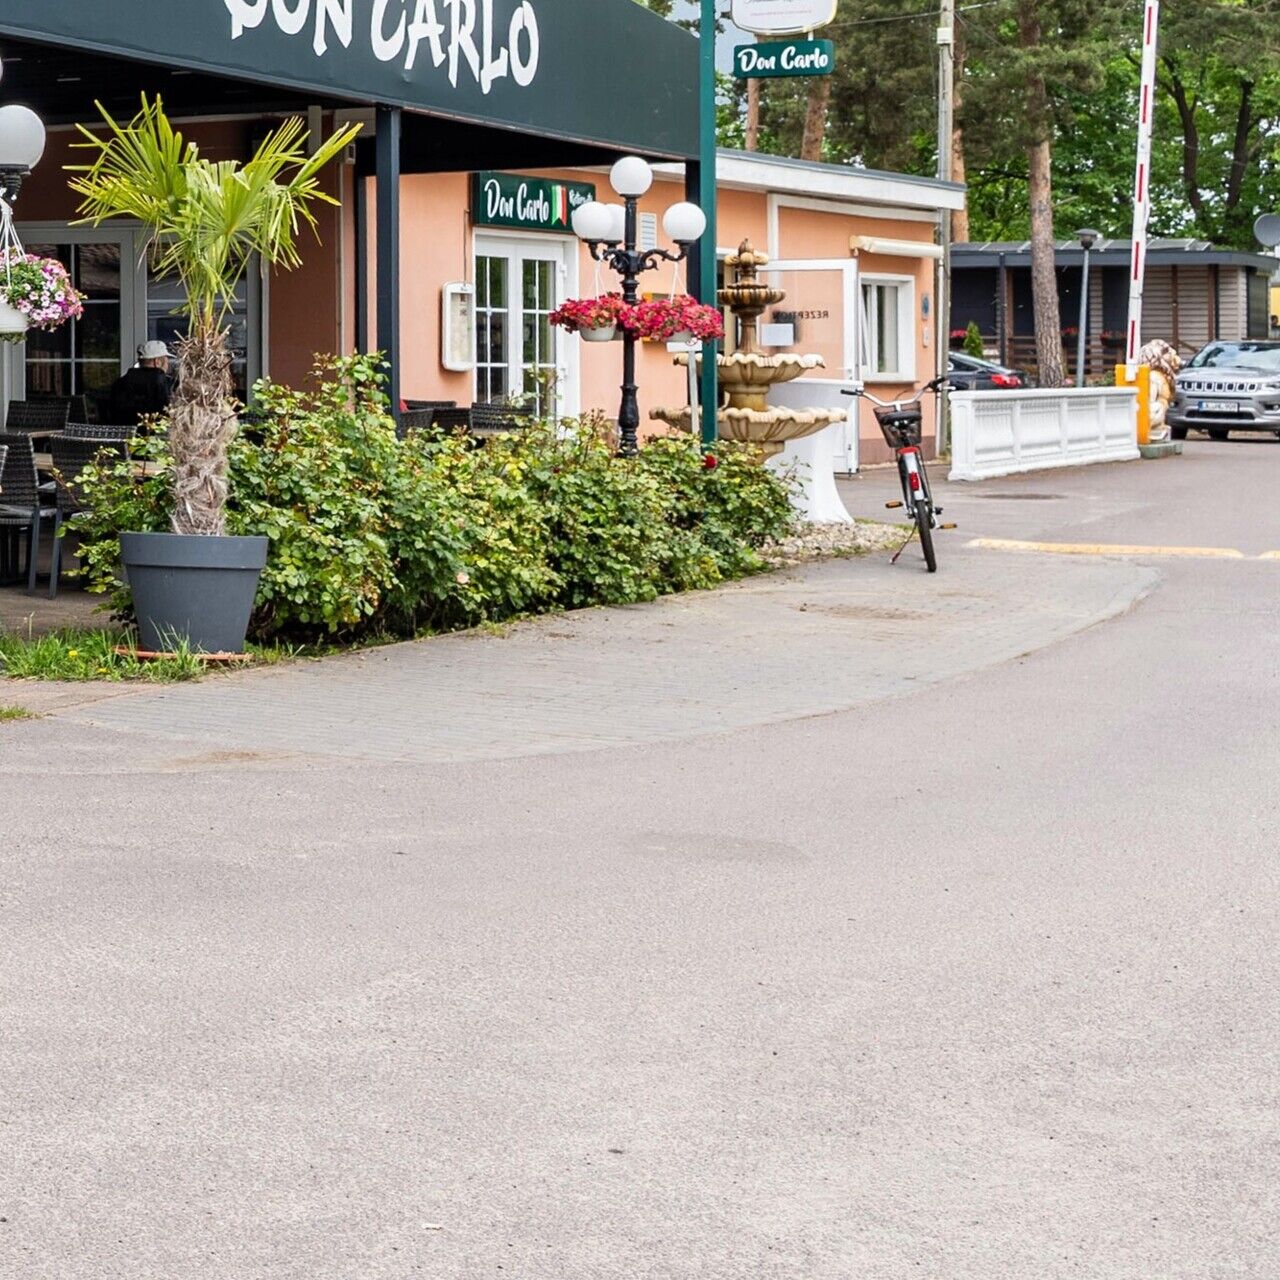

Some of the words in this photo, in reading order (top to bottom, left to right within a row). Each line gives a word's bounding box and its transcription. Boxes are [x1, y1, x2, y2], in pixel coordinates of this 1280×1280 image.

[737, 48, 776, 71] Don
[781, 46, 829, 70] Carlo
[484, 179, 514, 218] Don
[517, 183, 550, 223] Carlo
